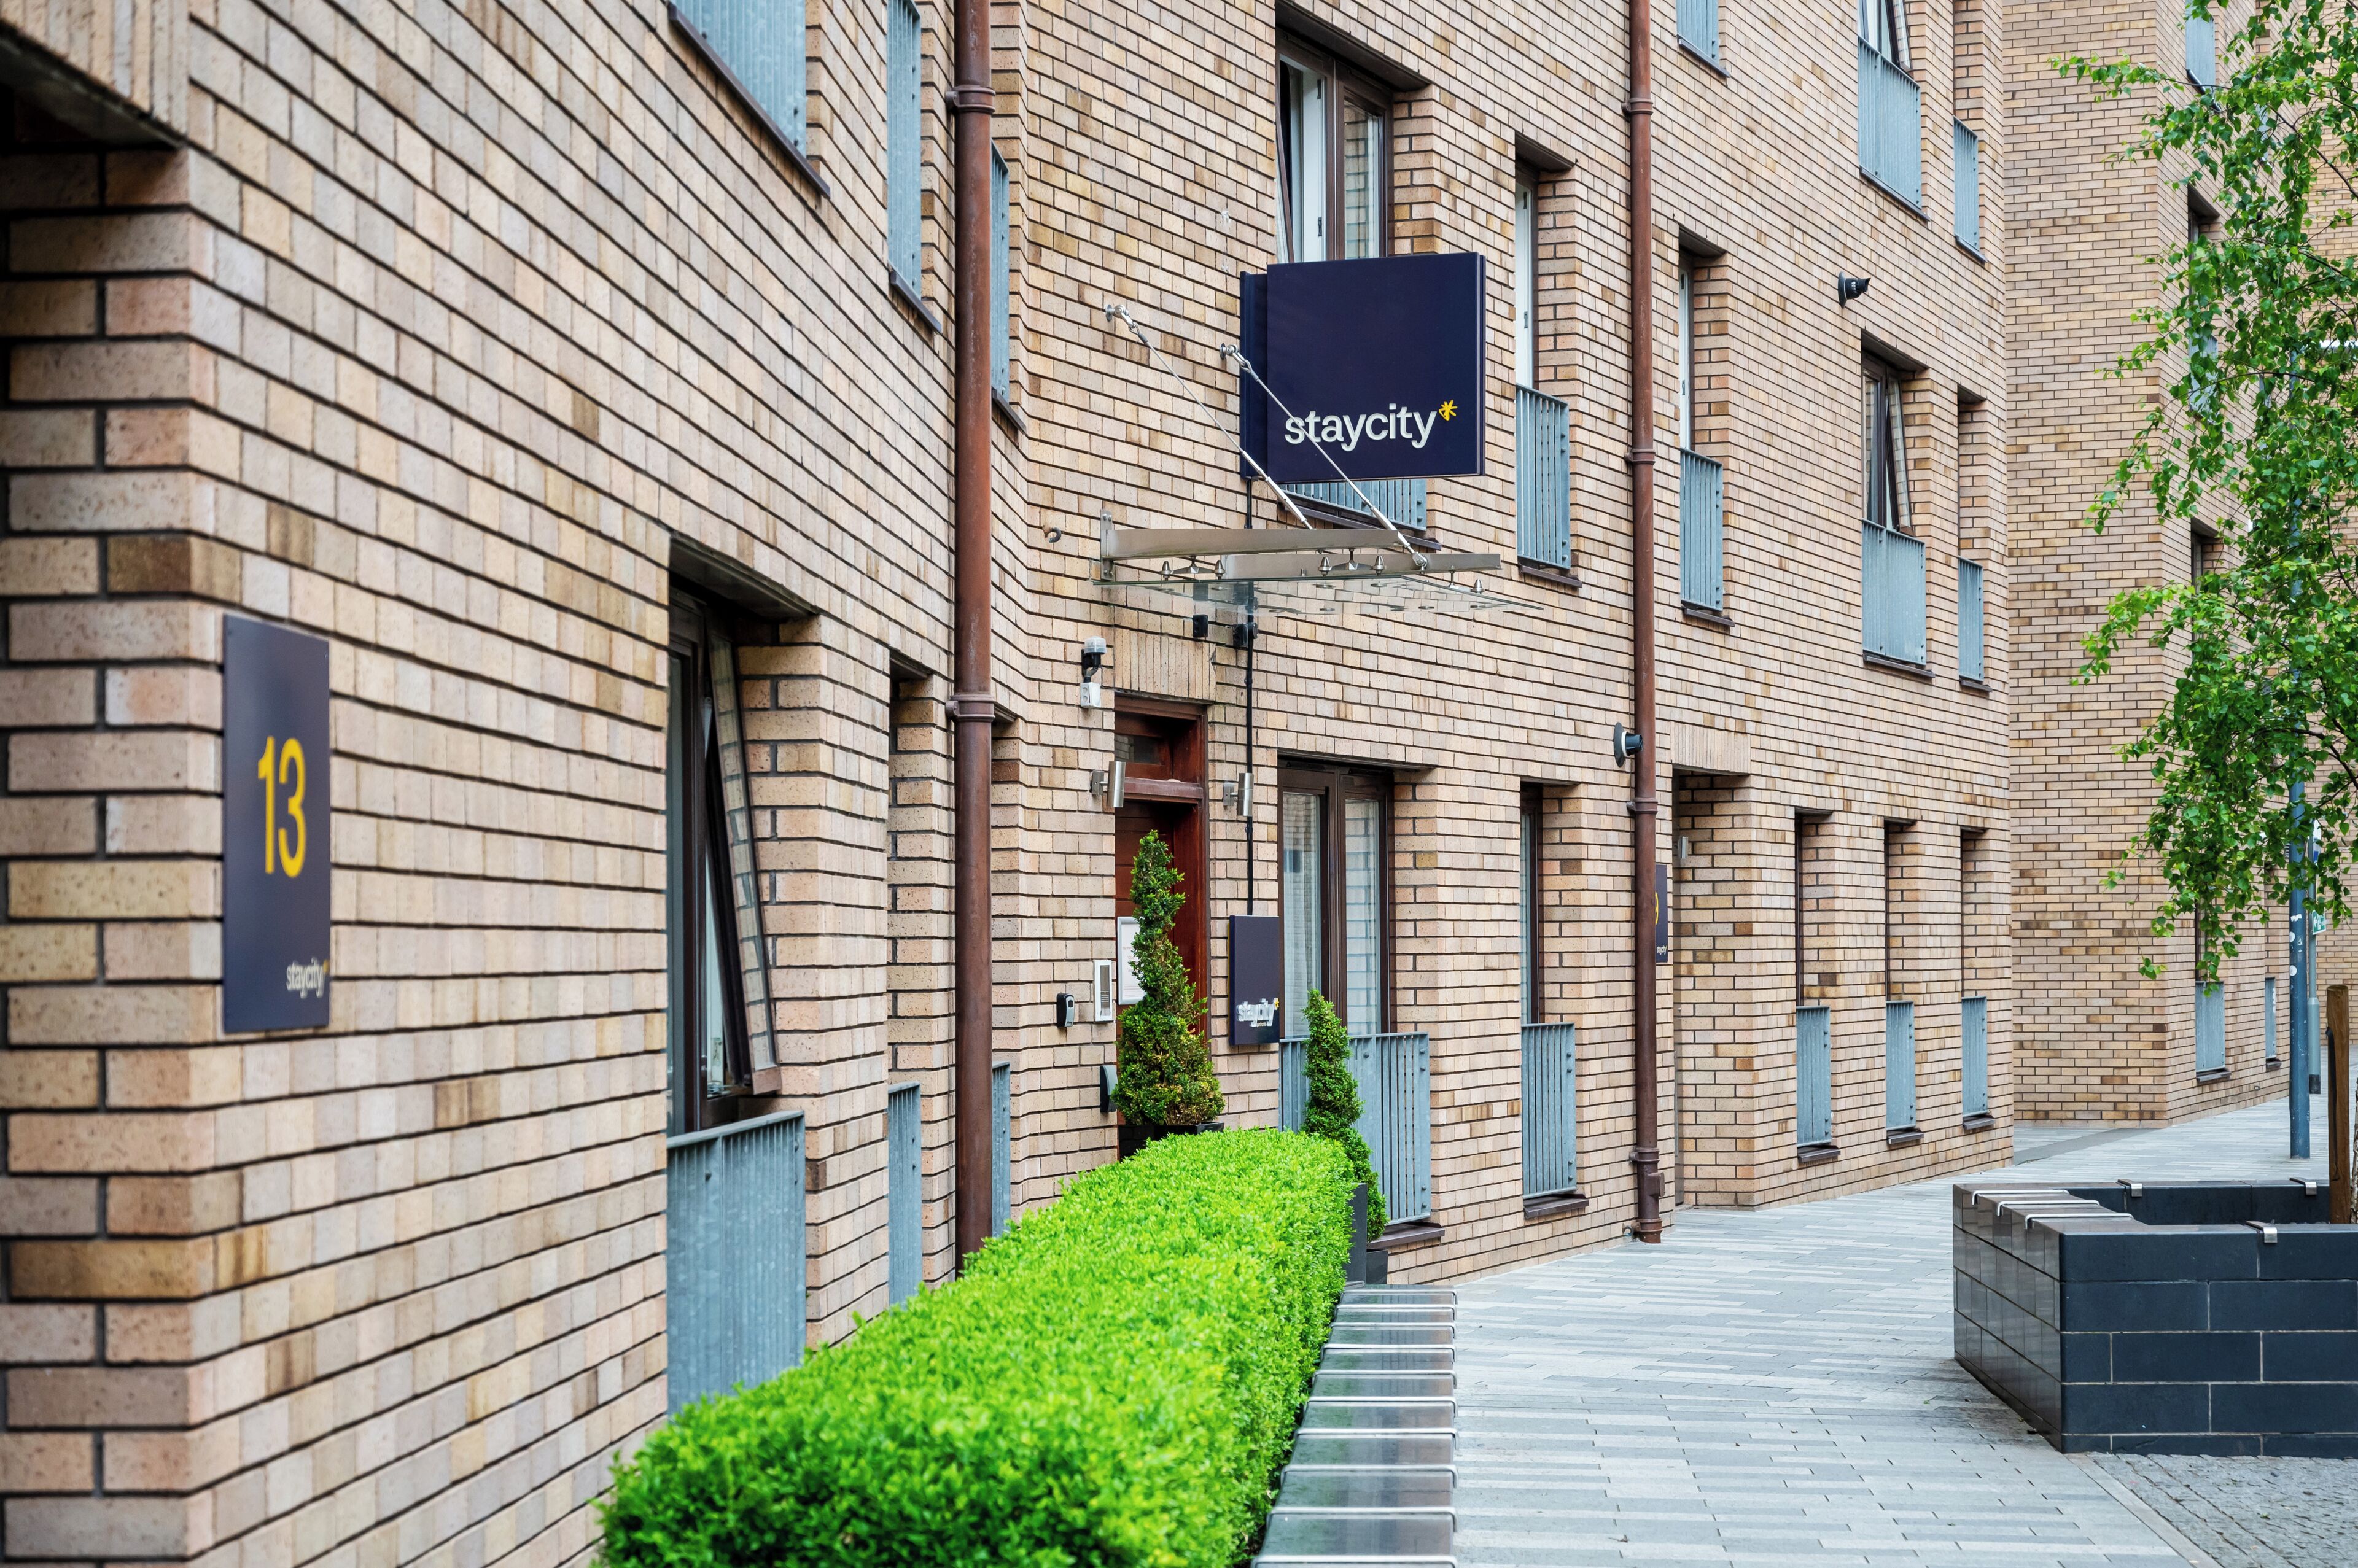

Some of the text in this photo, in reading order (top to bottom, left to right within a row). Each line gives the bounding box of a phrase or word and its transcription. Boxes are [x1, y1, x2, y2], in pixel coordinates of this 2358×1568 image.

[1285, 402, 1438, 452] staycity
[258, 735, 306, 878] 13
[286, 957, 325, 999] staycity
